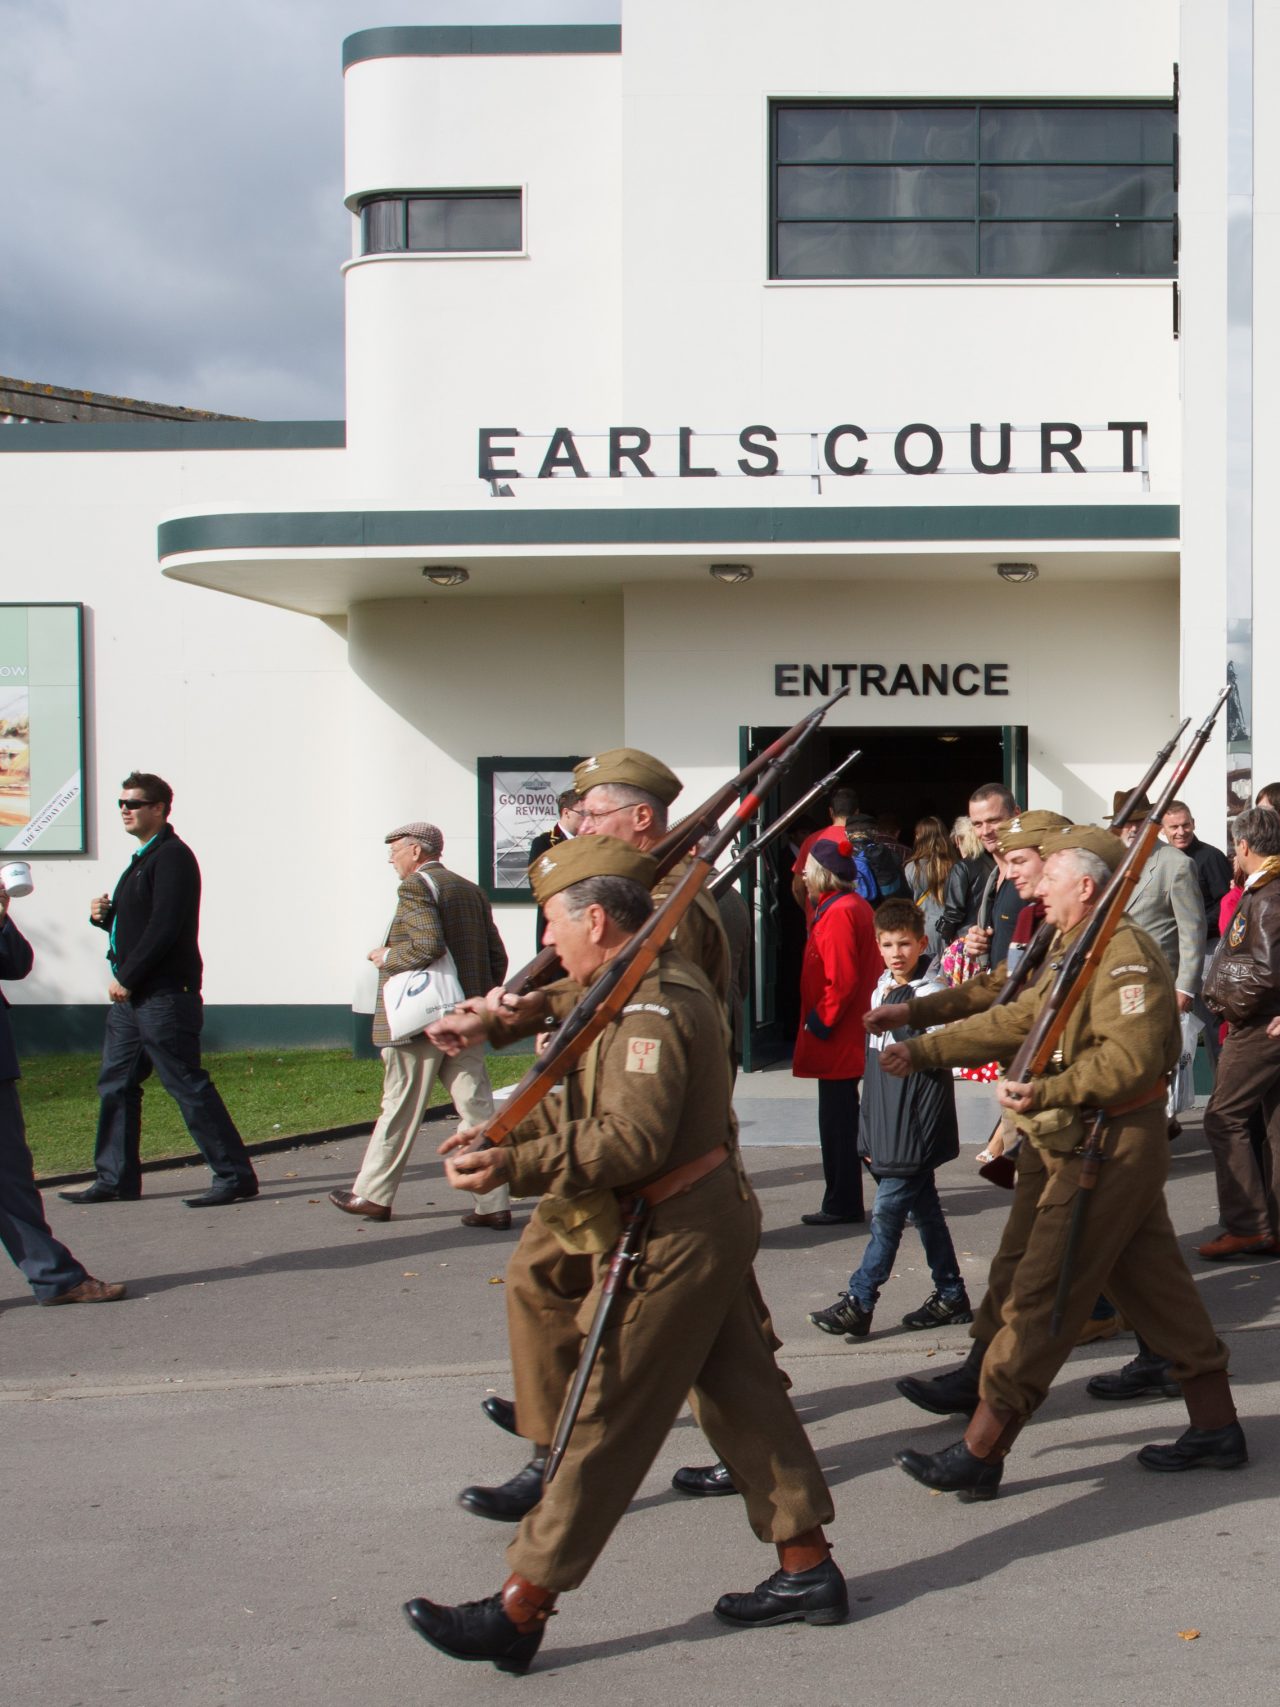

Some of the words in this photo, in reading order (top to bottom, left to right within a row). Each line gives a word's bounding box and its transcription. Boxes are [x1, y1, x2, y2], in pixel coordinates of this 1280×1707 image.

[478, 425, 780, 478] EARLS
[824, 422, 1148, 476] COURT
[775, 663, 1009, 697] ENTRANCE
[499, 794, 558, 805] GOODWO
[21, 833, 35, 847] THE
[34, 806, 60, 834] SUNDAY
[58, 785, 80, 808] TIMES
[516, 806, 557, 816] REVIVAL
[1124, 988, 1142, 1000] CP
[632, 1040, 656, 1055] CP
[638, 1058, 644, 1070] 1
